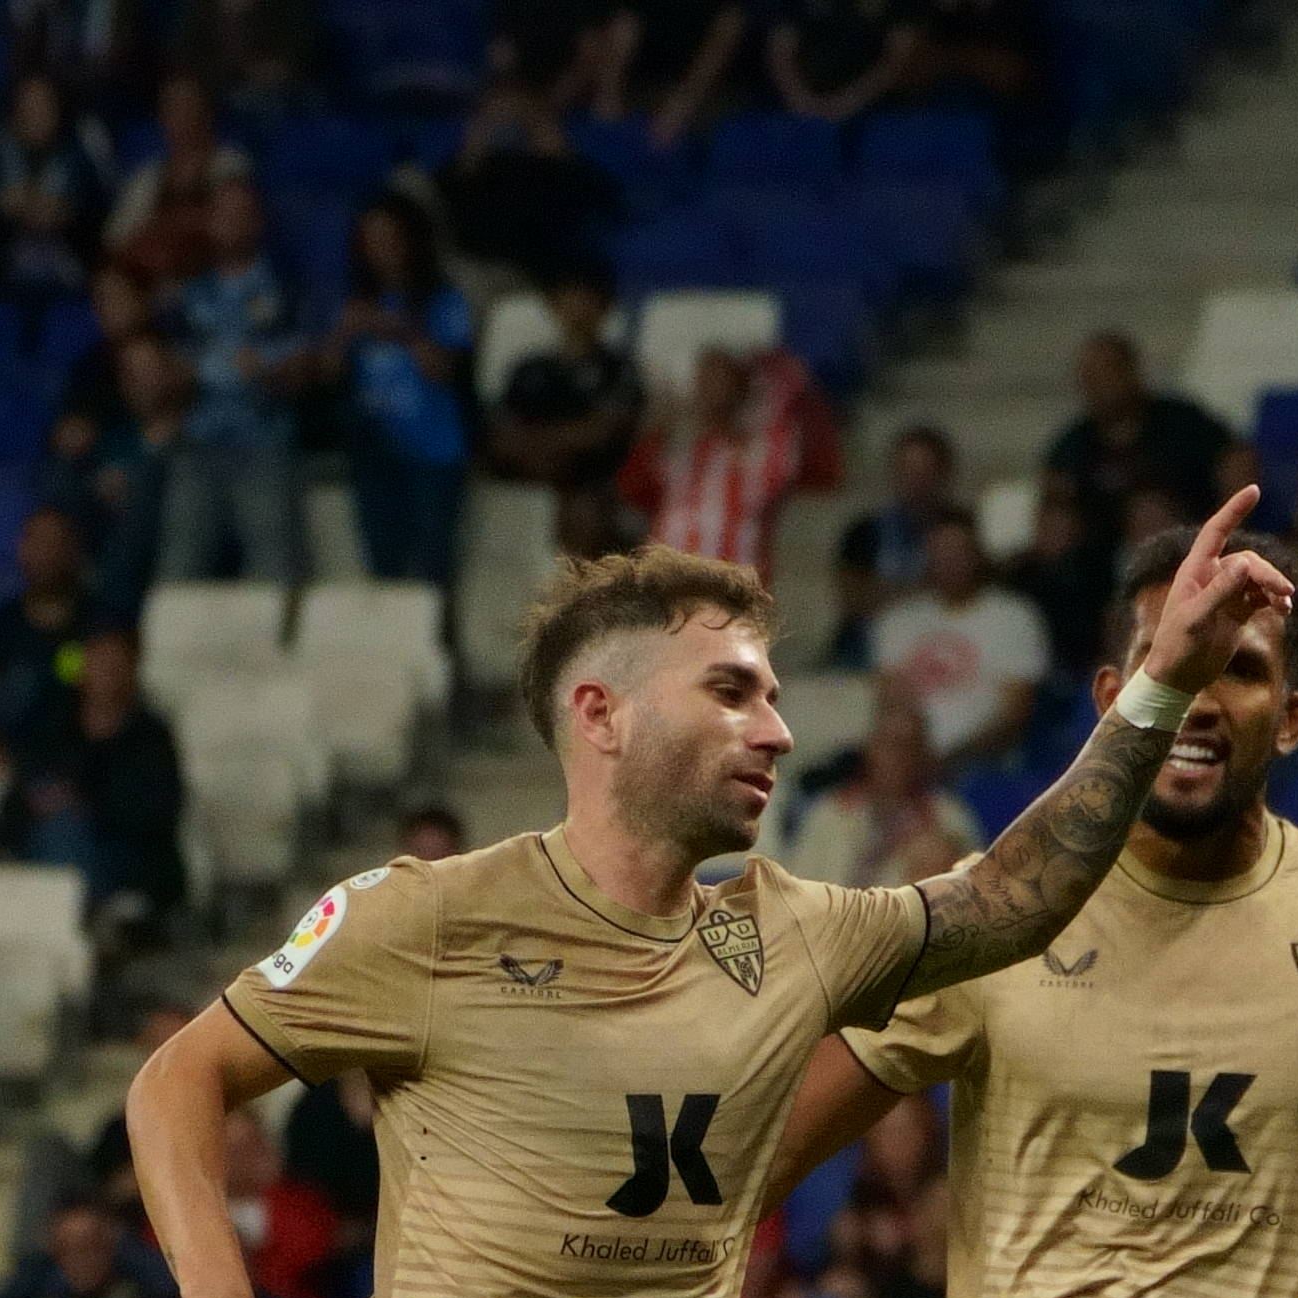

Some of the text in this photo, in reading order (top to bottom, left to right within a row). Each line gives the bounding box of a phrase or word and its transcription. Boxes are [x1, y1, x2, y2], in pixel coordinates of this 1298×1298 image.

[706, 922, 751, 942] U D
[1111, 1069, 1258, 1181] JK
[605, 1093, 723, 1218] JK
[1077, 1187, 1159, 1220] Khaled
[1165, 1199, 1241, 1223] Juffali
[560, 1233, 648, 1261] Khaled
[654, 1238, 719, 1263] Juffali
